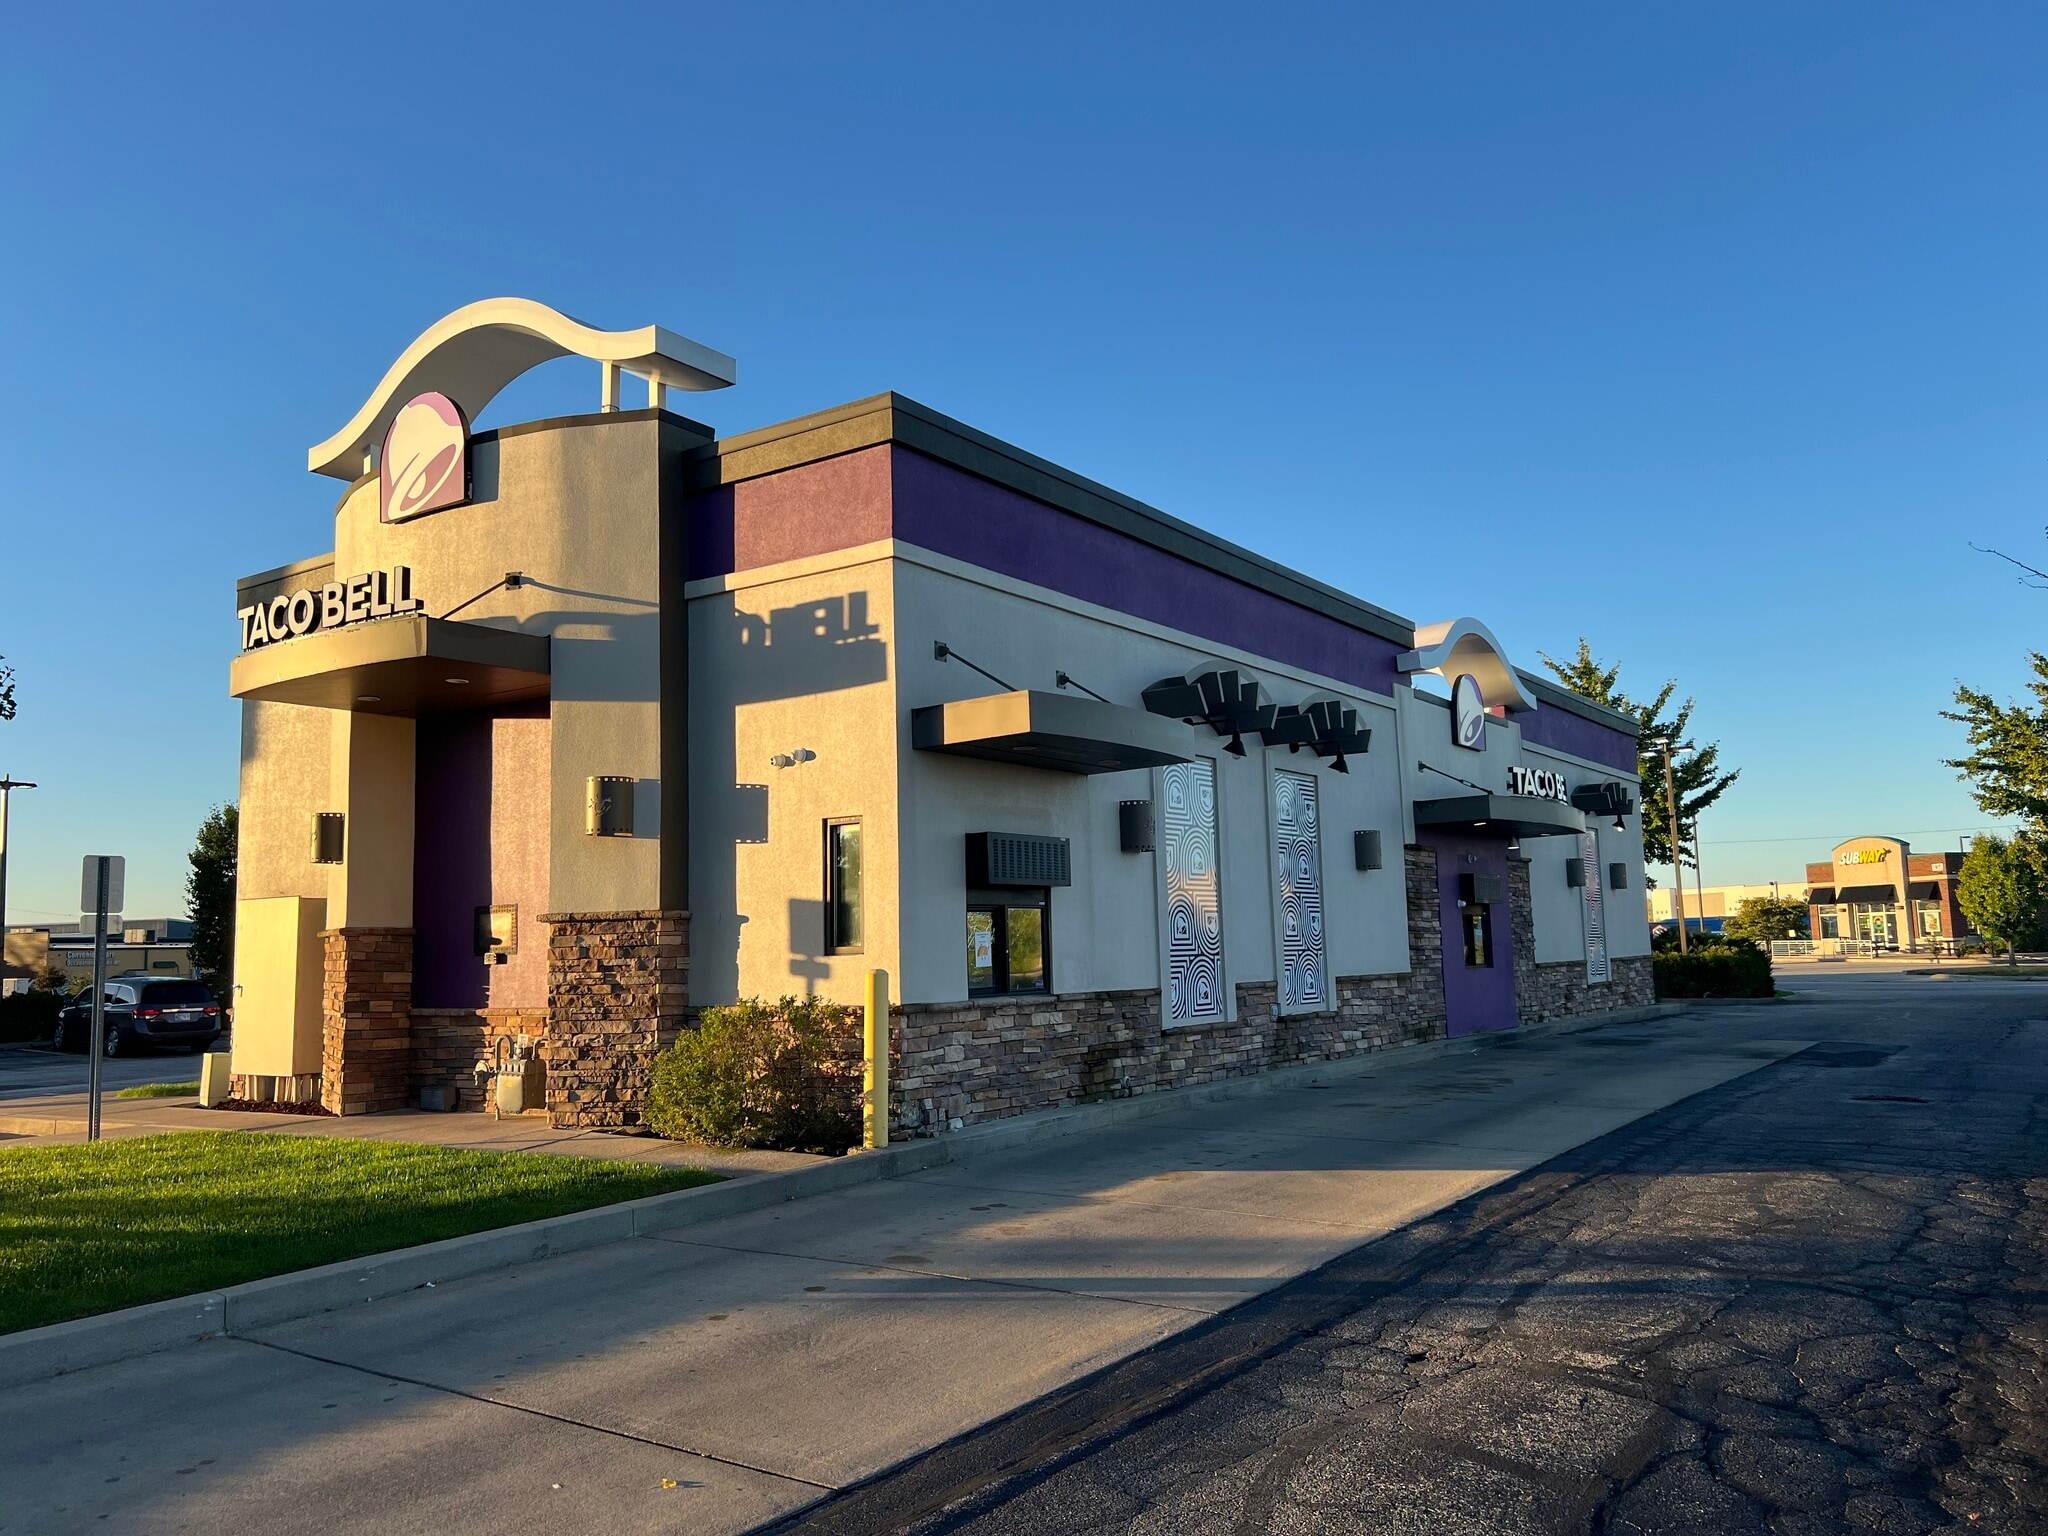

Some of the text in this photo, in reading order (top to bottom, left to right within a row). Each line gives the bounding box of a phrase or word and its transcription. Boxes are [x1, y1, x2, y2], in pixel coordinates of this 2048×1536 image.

[237, 565, 423, 650] TACO BELL
[1511, 766, 1556, 798] TACO
[1838, 849, 1887, 864] SUBWAY
